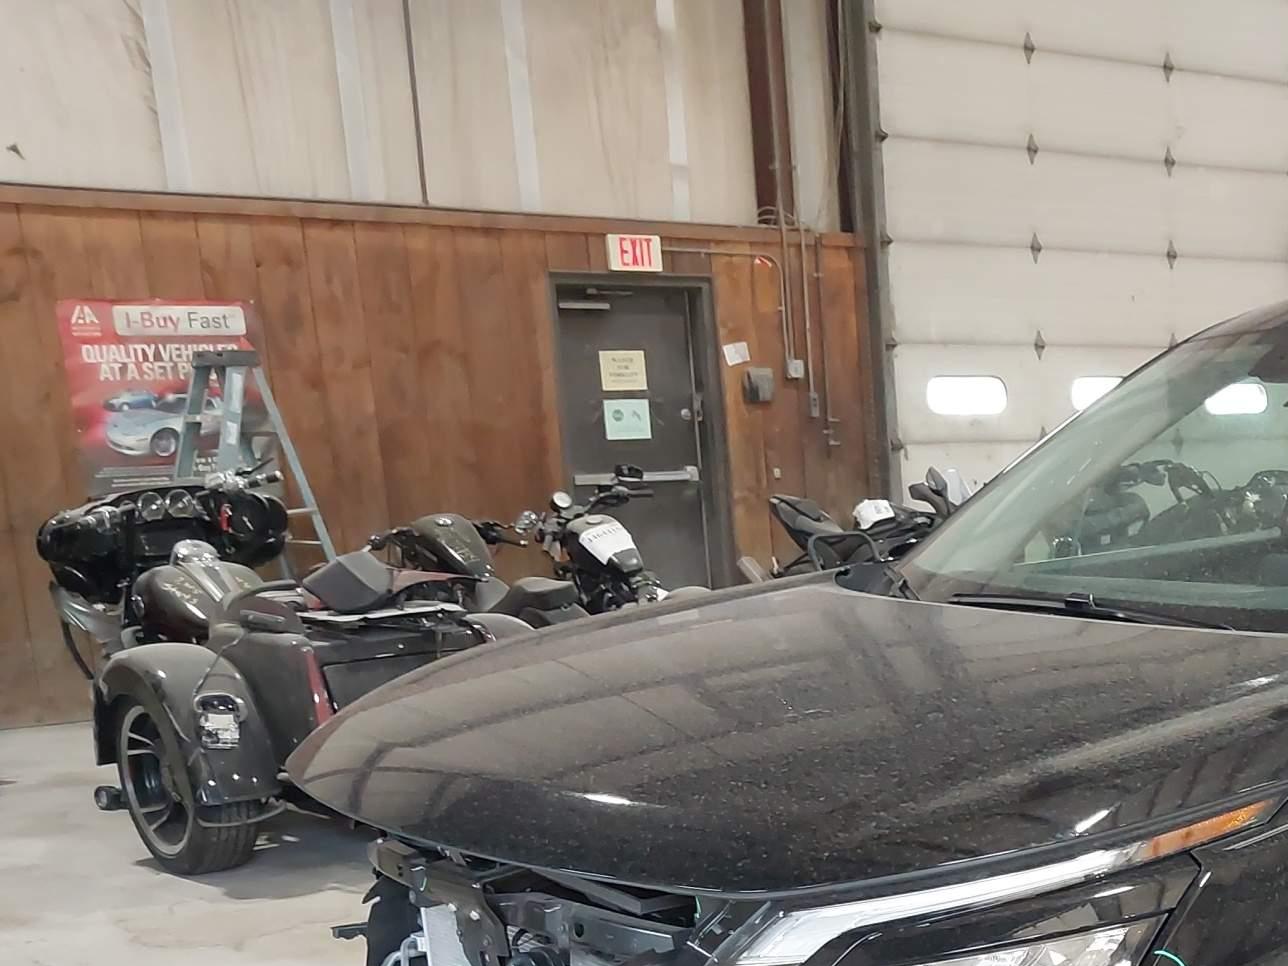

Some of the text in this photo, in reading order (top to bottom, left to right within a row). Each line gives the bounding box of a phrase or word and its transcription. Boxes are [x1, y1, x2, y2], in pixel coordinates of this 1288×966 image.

[619, 237, 652, 267] EXIT
[126, 311, 230, 332] I-Buy Fast
[82, 344, 160, 363] QUALITY
[100, 363, 126, 381] AT
[127, 363, 142, 381] A
[143, 362, 176, 380] SET
